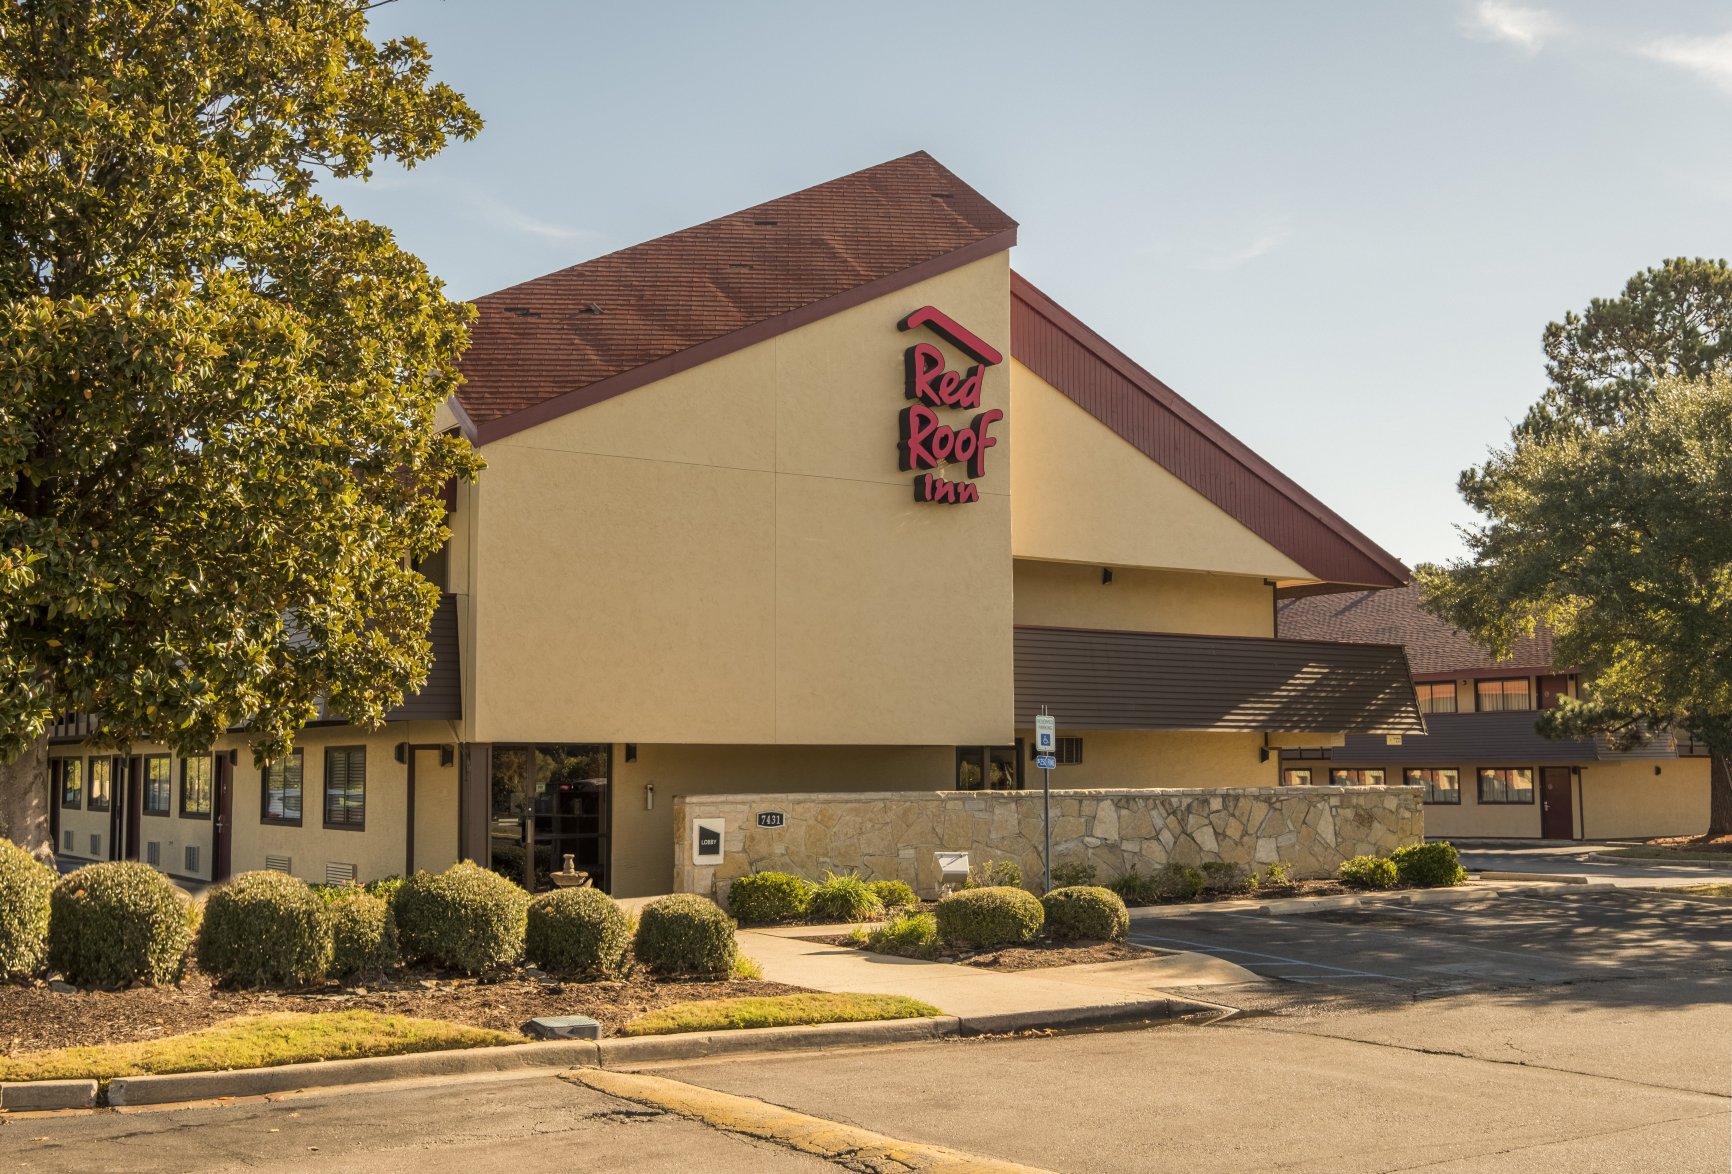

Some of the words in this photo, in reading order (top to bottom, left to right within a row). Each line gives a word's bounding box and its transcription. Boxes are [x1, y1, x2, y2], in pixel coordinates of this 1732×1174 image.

[912, 343, 985, 408] Red
[906, 404, 1003, 478] Roof
[921, 473, 979, 504] Inn
[761, 815, 780, 825] 7431
